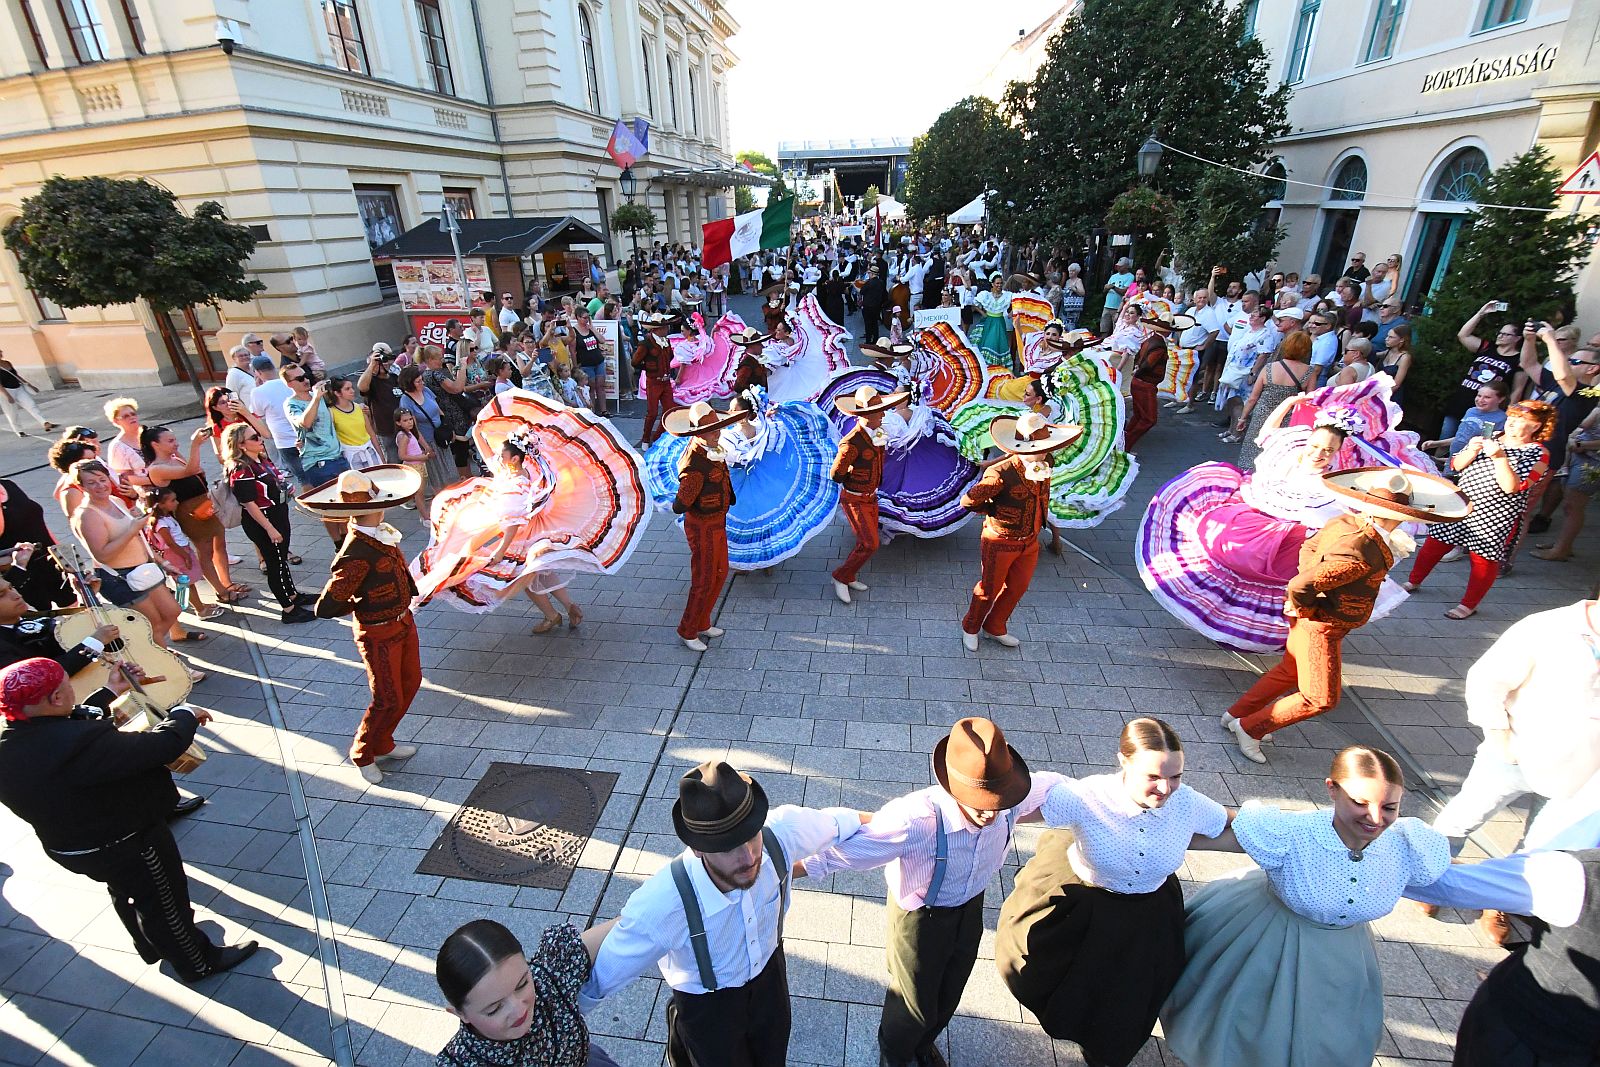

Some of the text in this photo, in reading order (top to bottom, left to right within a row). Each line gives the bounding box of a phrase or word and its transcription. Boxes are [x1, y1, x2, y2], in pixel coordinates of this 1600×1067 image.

[1421, 43, 1558, 93] BORTÁRSASÁG
[420, 322, 449, 349] Lep
[1461, 378, 1482, 390] MOU
